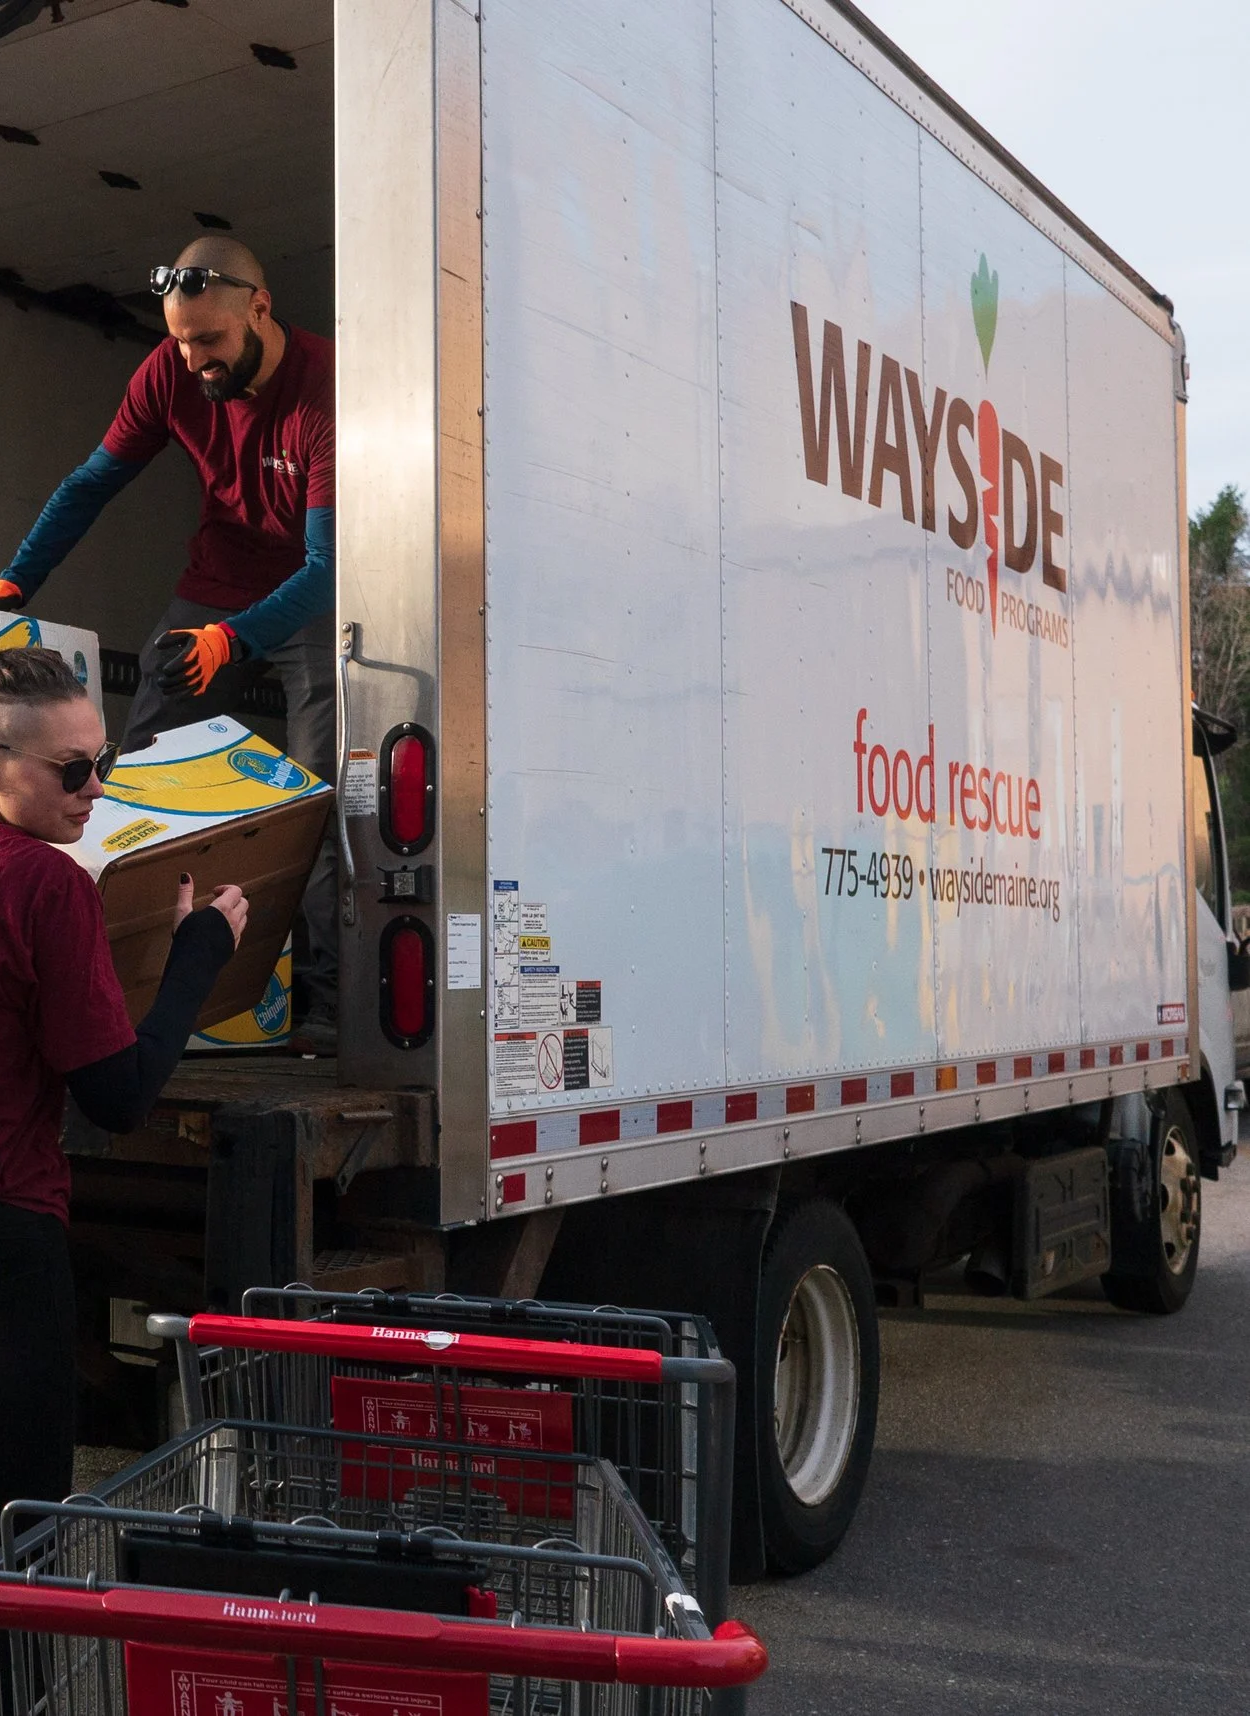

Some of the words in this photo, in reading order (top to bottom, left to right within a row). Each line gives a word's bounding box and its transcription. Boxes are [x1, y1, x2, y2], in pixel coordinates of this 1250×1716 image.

[790, 300, 1067, 594] WAYSIDE
[947, 567, 985, 614] FOOD
[1001, 591, 1068, 649] PROGRAMS
[267, 758, 294, 789] Chiquita
[853, 708, 936, 823] food
[949, 761, 1041, 840] rescue
[118, 834, 140, 850] CLASS
[138, 825, 160, 842] EXTRA
[821, 847, 914, 900] 775-4939
[930, 857, 1061, 923] waysidemaine.org
[256, 994, 288, 1029] Chiquita
[361, 1692, 389, 1701] serious
